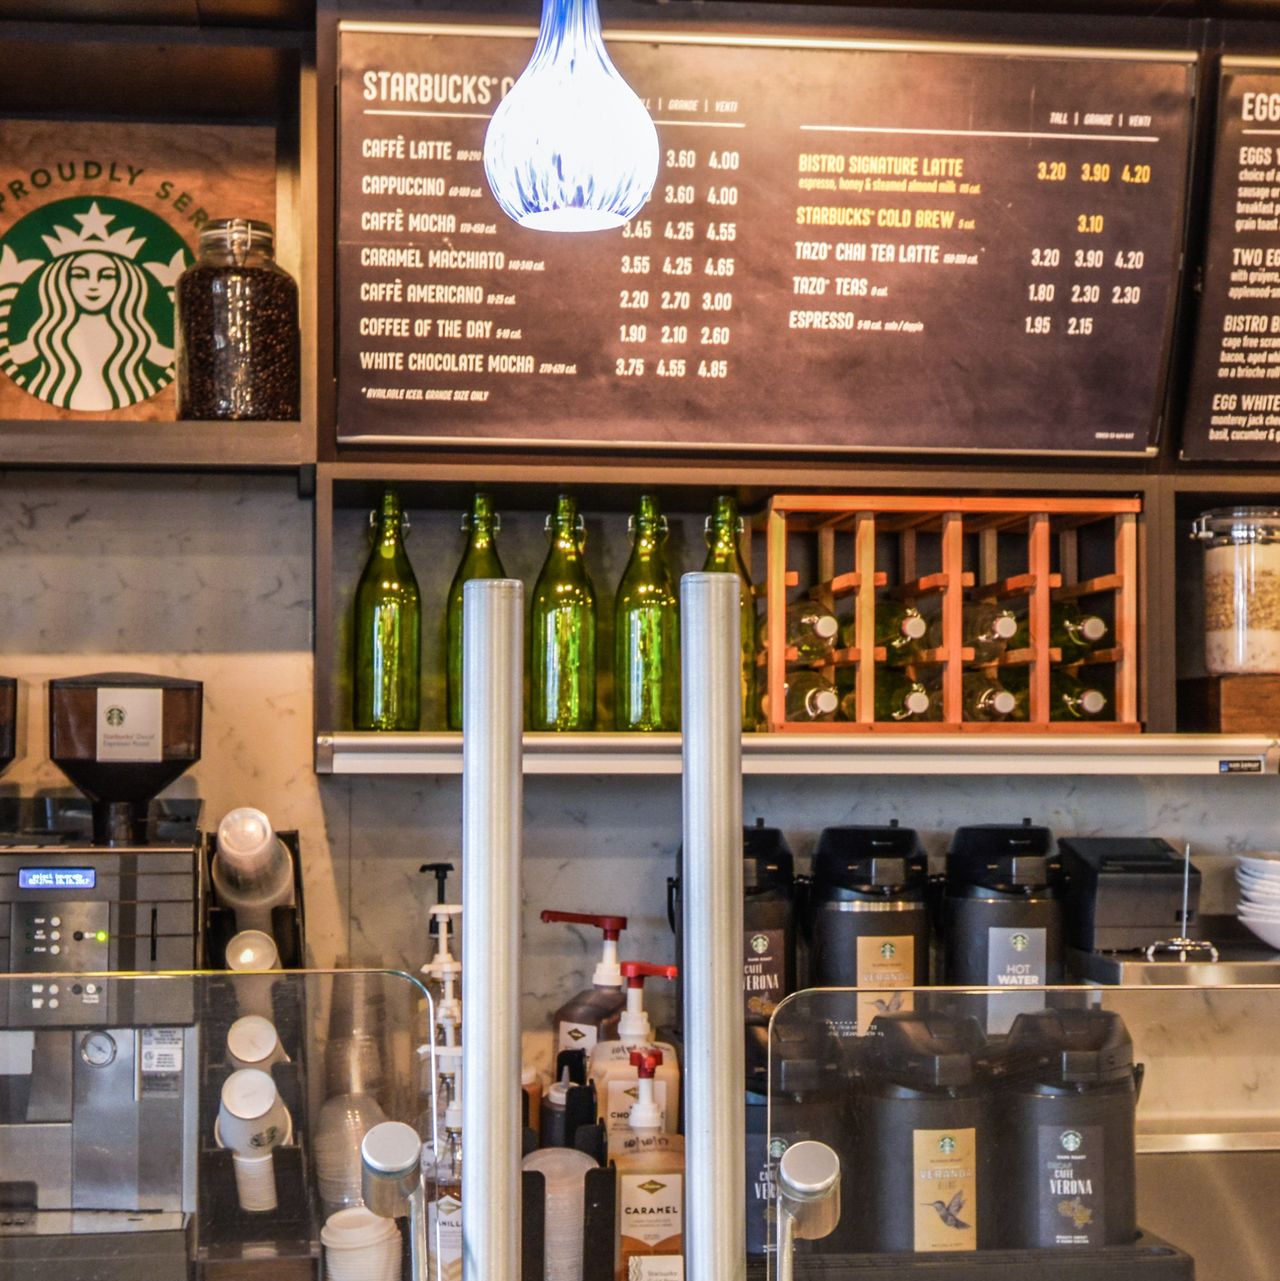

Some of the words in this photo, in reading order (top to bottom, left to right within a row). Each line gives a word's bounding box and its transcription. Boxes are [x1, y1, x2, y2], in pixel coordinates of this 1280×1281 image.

[668, 99, 699, 111] GRANDE
[715, 101, 738, 112] VENTI
[1049, 112, 1068, 124] TALL
[1083, 113, 1113, 126] GRANDE
[1128, 114, 1151, 127] VENTI
[362, 135, 405, 159] CAFFÈ
[410, 140, 452, 160] LATTE
[666, 150, 695, 168] 3.60
[709, 152, 739, 169] 4.00
[1239, 147, 1271, 165] EGGS
[799, 154, 845, 172] BISTRO
[849, 156, 918, 175] SIGNATURE
[922, 158, 963, 177] LATTE
[1038, 162, 1066, 181] 3.20
[1081, 163, 1110, 182] 3.90
[1122, 164, 1151, 183] 4.20
[1238, 169, 1264, 182] choice
[1266, 169, 1275, 181] of
[362, 176, 444, 197] CAPPUCCINO
[665, 186, 694, 204] 3.60
[707, 187, 737, 205] 4.00
[798, 178, 837, 191] espresso,
[839, 177, 864, 192] honey
[865, 178, 871, 190] &
[872, 178, 907, 192] steamed
[908, 180, 937, 192] almond
[938, 180, 956, 193] milk
[155, 181, 209, 229] SER
[361, 208, 404, 231] CAFFÈ
[409, 213, 455, 233] MOCHA
[623, 221, 651, 239] 3.45
[664, 222, 694, 240] 4.25
[707, 222, 736, 241] 4.55
[877, 208, 911, 227] COLD
[915, 210, 955, 228] BREW
[1078, 215, 1103, 233] 3.10
[361, 248, 424, 268] CARAMEL
[429, 251, 504, 270] MACCHIATO
[621, 256, 650, 273] 3.55
[663, 257, 692, 275] 4.25
[705, 258, 734, 276] 4.65
[835, 243, 866, 261] CHAI
[871, 244, 895, 262] TEA
[899, 245, 939, 263] LATTE
[1031, 249, 1059, 267] 3.20
[1075, 250, 1103, 268] 3.90
[1115, 251, 1144, 269] 4.20
[1233, 248, 1263, 267] TWO
[360, 279, 402, 302] CAFFÈ
[407, 285, 483, 304] AMERICANO
[620, 291, 649, 308] 2.20
[661, 292, 690, 310] 2.70
[702, 293, 732, 311] 3.00
[835, 278, 868, 296] TEAS
[1029, 284, 1054, 301] 1.80
[1071, 286, 1100, 302] 2.30
[1112, 287, 1141, 304] 2.30
[360, 318, 410, 337] COFFEE
[415, 319, 431, 337] OF
[437, 319, 461, 338] THE
[467, 321, 492, 339] DAY
[620, 325, 646, 343] 1.90
[661, 326, 687, 344] 2.10
[701, 327, 730, 345] 2.60
[789, 311, 854, 329] ESPRESSO
[1025, 317, 1051, 334] 1.95
[1068, 318, 1093, 335] 2.15
[1223, 315, 1268, 332] BISTRO
[360, 352, 403, 370] WHITE
[408, 353, 483, 372] CHOCOLATE
[488, 355, 534, 374] MOCHA
[616, 359, 644, 376] 3.75
[657, 360, 686, 377] 4.55
[698, 361, 727, 378] 4.85
[453, 390, 470, 400] SIZE
[470, 391, 489, 401] ONLY
[1212, 394, 1237, 411] EGG
[997, 975, 1039, 985] WATER
[1006, 964, 1031, 975] HOT
[744, 974, 779, 991] ERONA
[1050, 1179, 1093, 1195] VERONA
